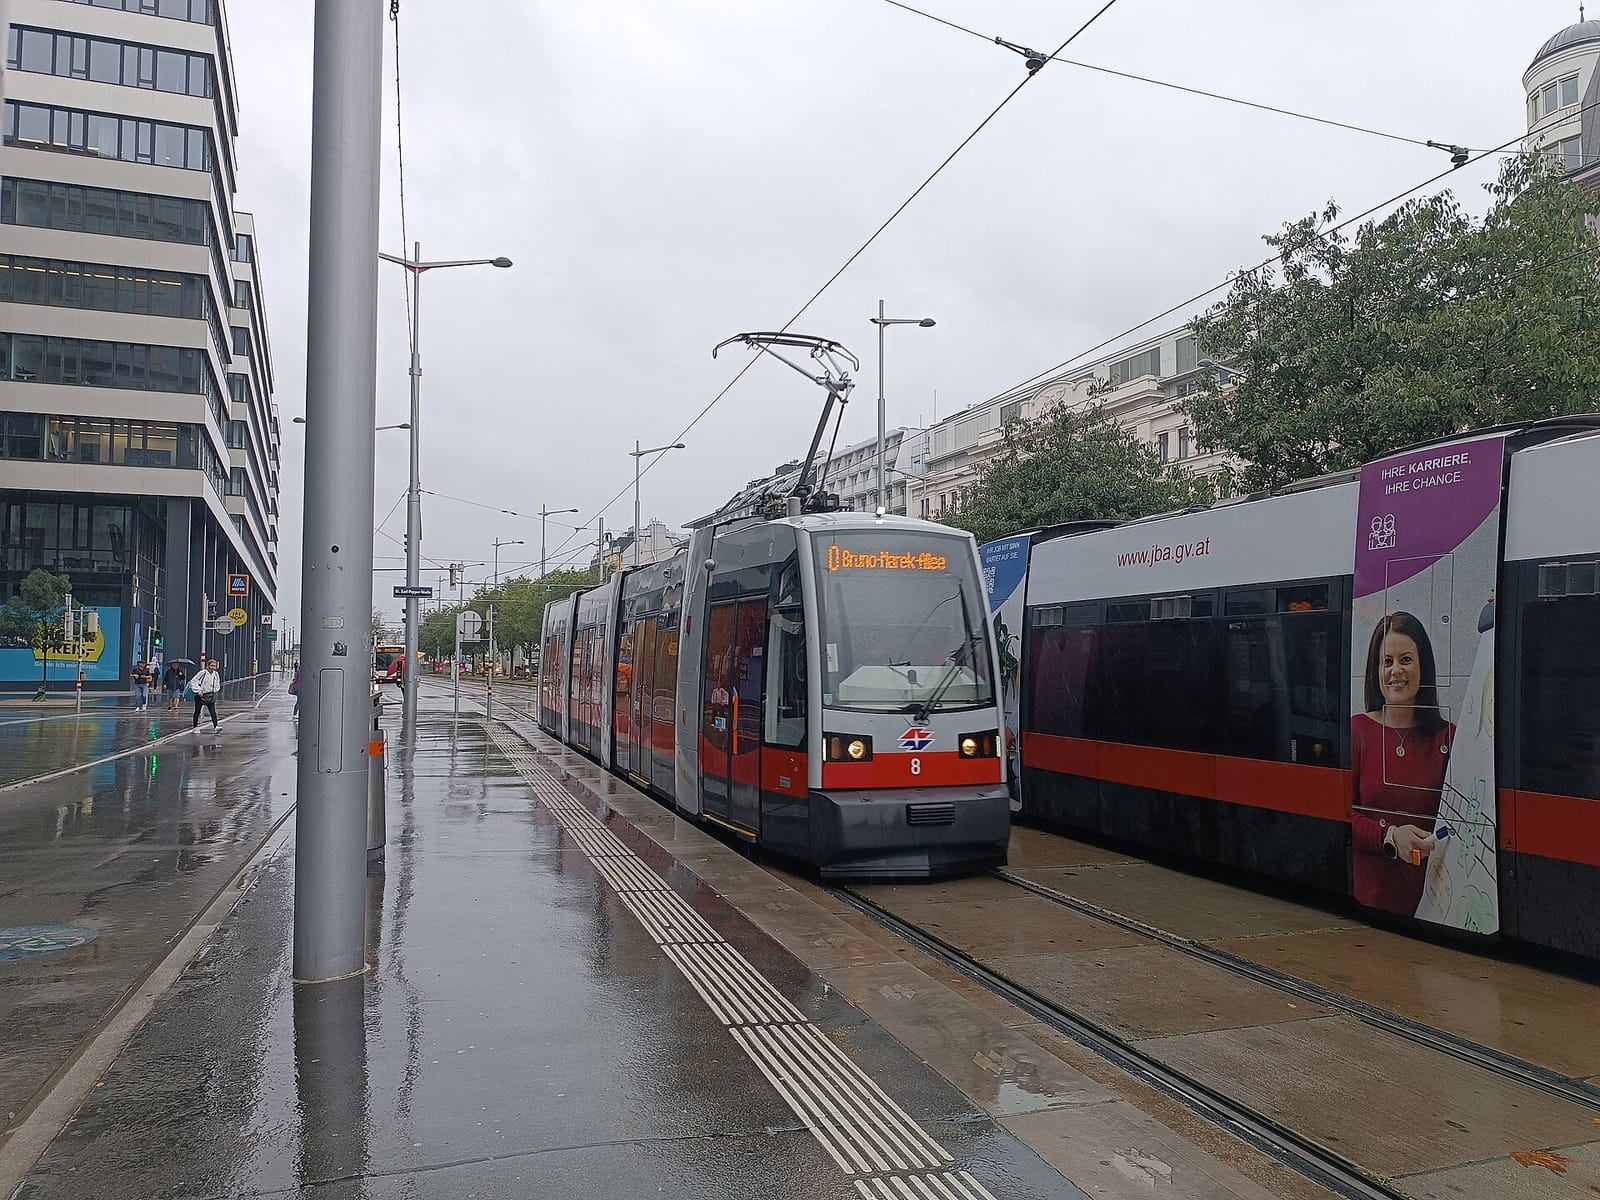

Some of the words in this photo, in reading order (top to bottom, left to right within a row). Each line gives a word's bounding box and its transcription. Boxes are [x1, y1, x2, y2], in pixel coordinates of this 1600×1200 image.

[1381, 465, 1406, 480] IHRE
[1408, 452, 1472, 474] KARRIERE,
[1385, 481, 1410, 495] IHRE
[1412, 471, 1464, 490] CHANCE.
[1117, 537, 1210, 568] www.jba.gv.at
[910, 757, 922, 775] 8
